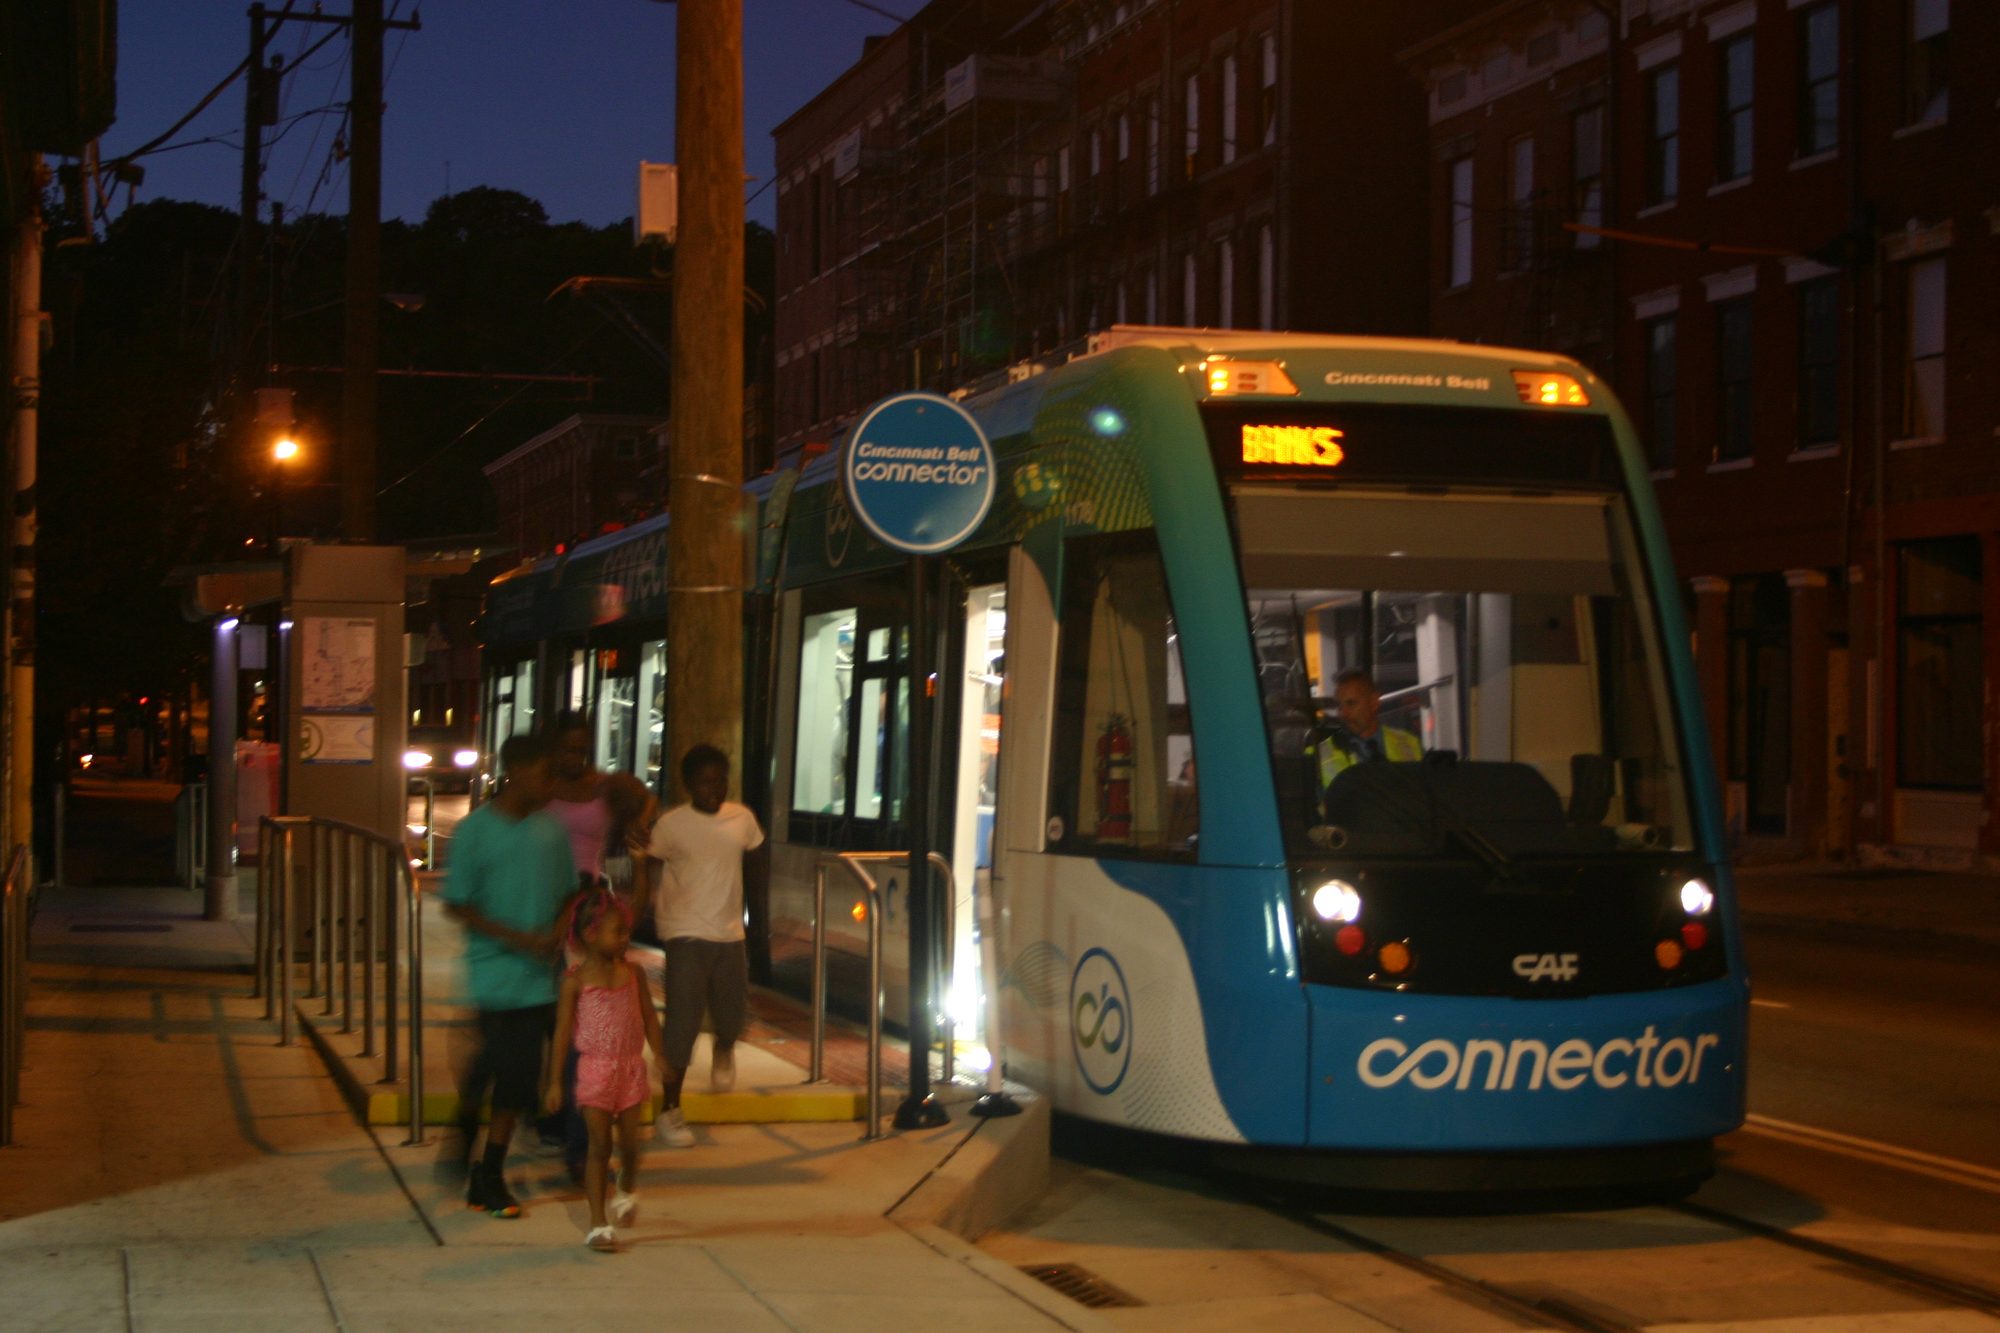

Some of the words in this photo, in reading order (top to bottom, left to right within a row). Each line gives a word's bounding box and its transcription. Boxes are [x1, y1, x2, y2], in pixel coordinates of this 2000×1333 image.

[1324, 371, 1442, 387] Cincinnati
[1445, 375, 1491, 391] Bell
[858, 442, 942, 459] Cincinnati
[946, 446, 981, 462] Bell
[855, 461, 986, 485] connector
[1512, 953, 1579, 982] CAF
[1357, 1025, 1719, 1090] connector
